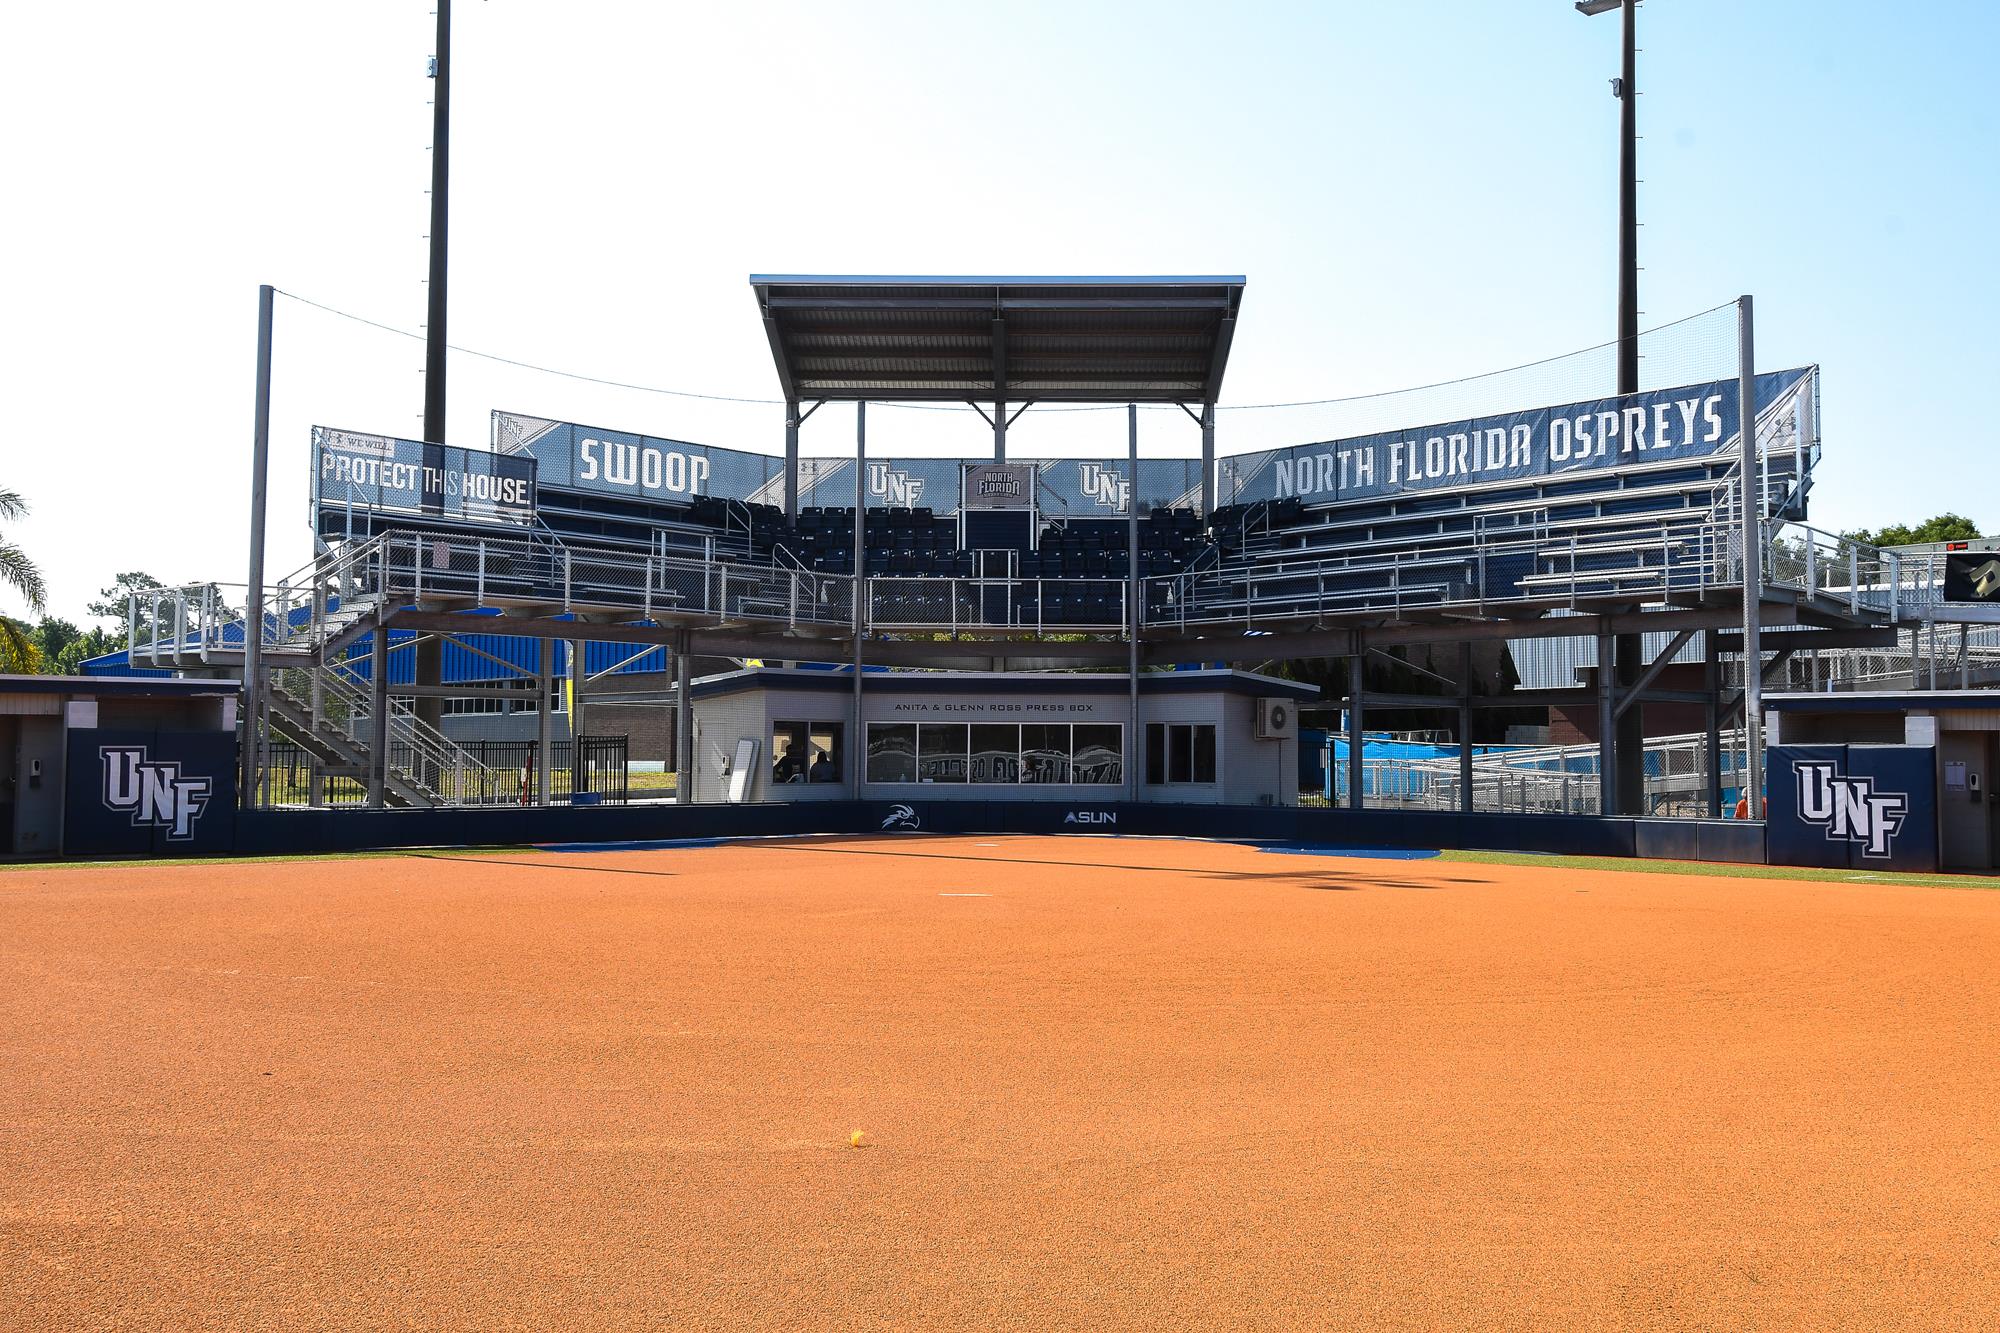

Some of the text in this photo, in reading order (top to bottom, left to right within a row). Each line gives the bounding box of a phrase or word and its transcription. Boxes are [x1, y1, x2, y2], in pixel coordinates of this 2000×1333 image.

[580, 438, 710, 495] SWOOP
[1275, 394, 1722, 499] NORTH FLORIDA OSPREYS
[321, 452, 419, 490] PROTECT
[422, 466, 458, 495] THIS
[867, 463, 924, 510] UNF
[977, 479, 1020, 496] FLORIDA
[984, 472, 1013, 482] NORTH
[1079, 463, 1130, 513] UNF
[895, 704, 928, 712] ANITA
[1070, 704, 1093, 712] BOX
[100, 745, 212, 841] UNF
[1792, 760, 1908, 858] UNF
[1064, 811, 1116, 823] ASUN
